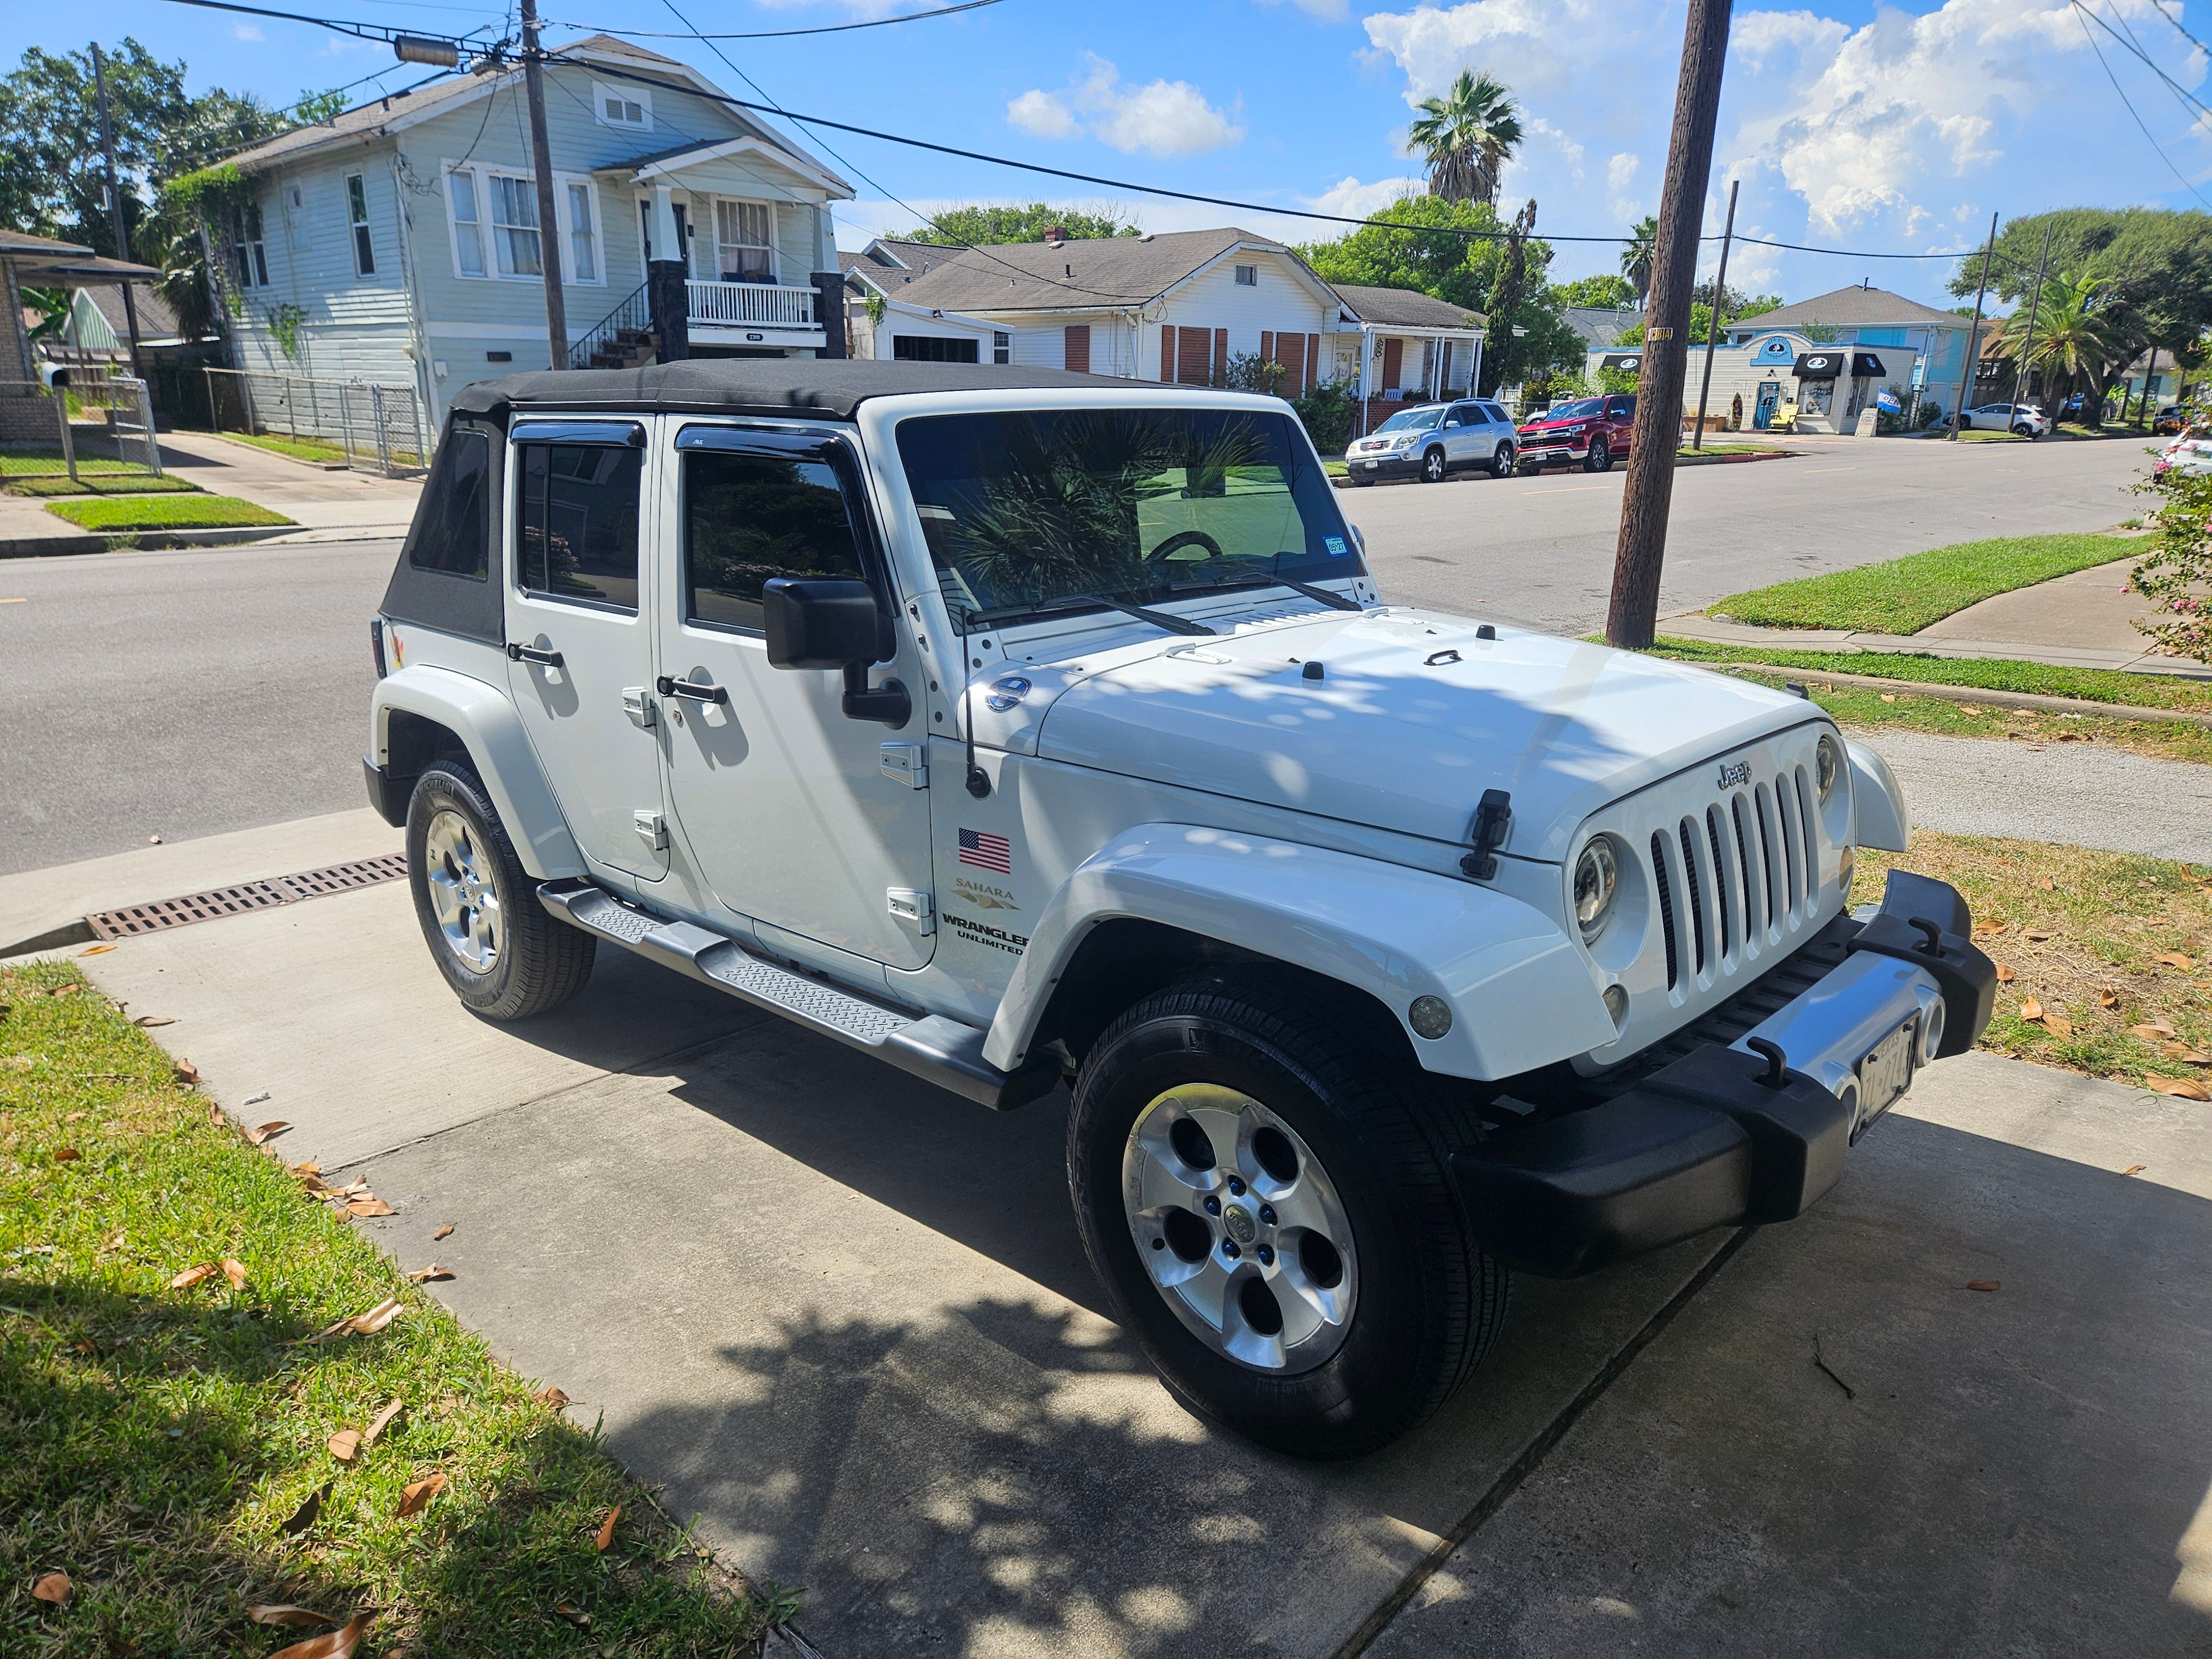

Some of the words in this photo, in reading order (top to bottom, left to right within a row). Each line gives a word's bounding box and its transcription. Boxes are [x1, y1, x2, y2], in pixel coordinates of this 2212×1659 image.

[1651, 328, 1670, 340] CBA
[1882, 395, 1900, 406] PEN
[1718, 761, 1752, 791] Jeep
[956, 878, 1014, 900] SAHARA
[957, 931, 1024, 956] UNLIMITED
